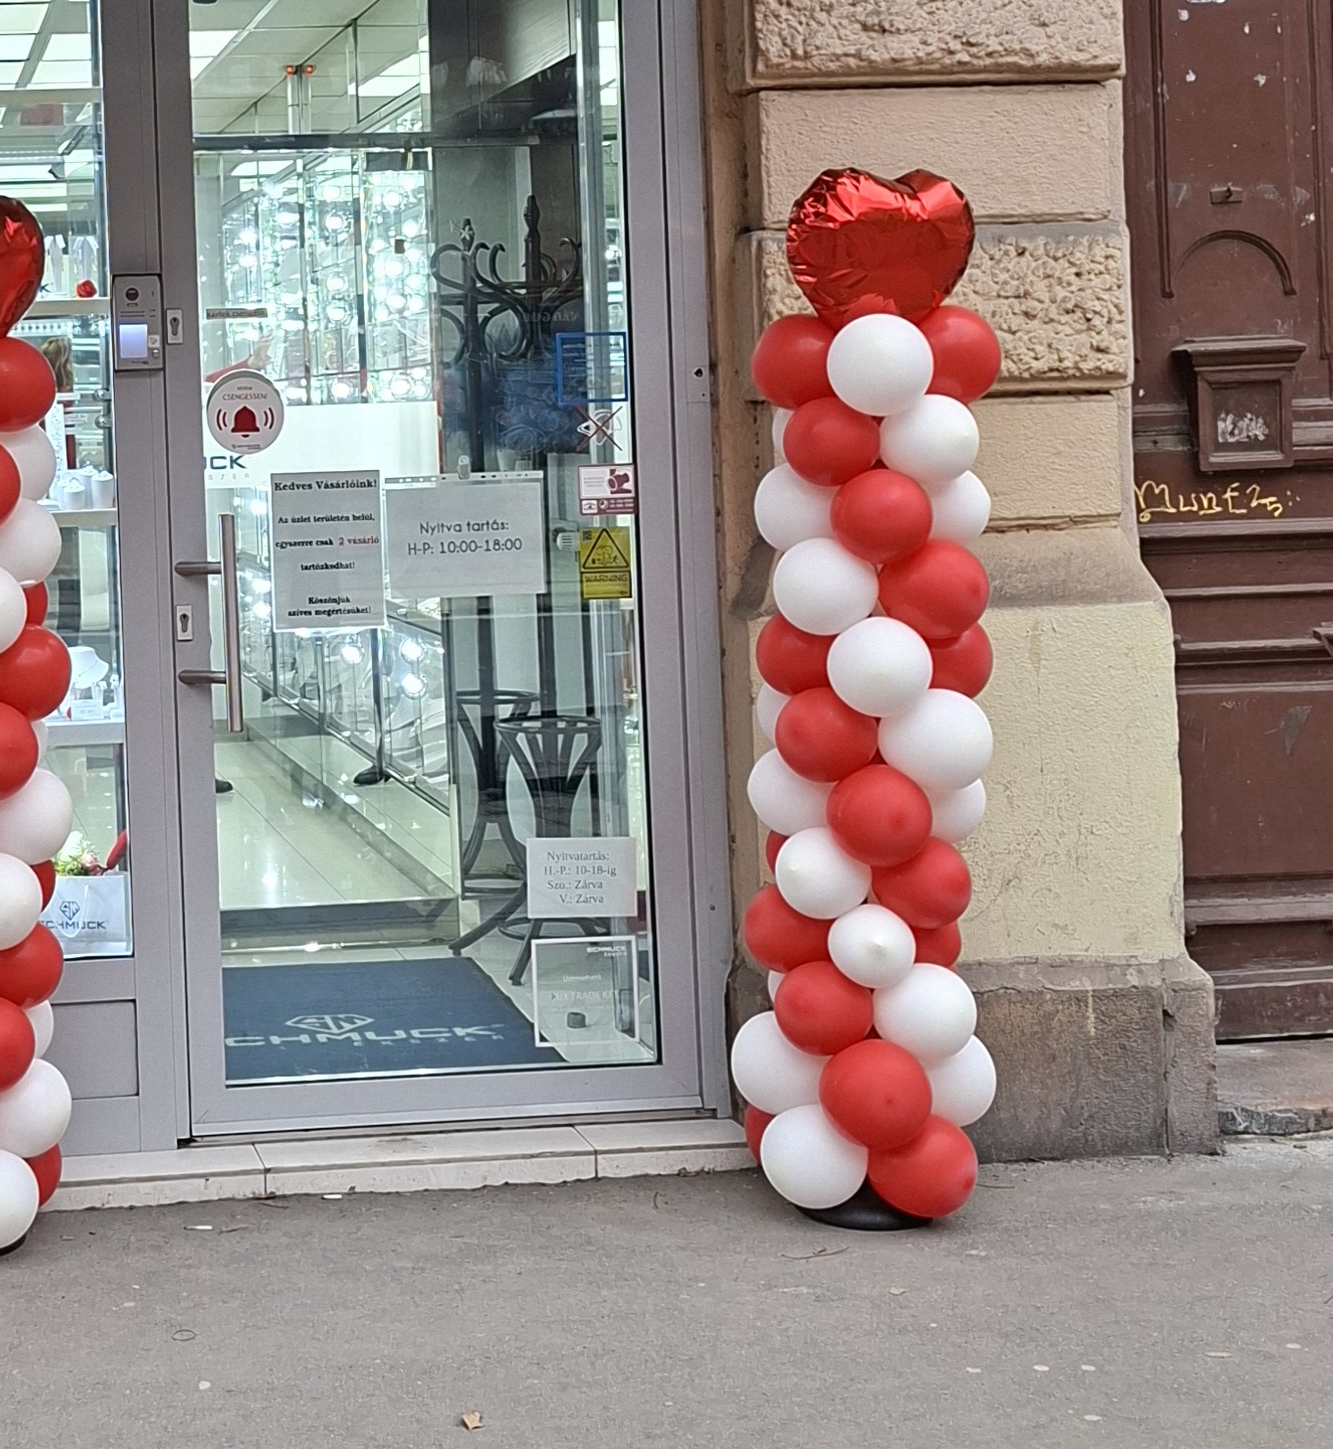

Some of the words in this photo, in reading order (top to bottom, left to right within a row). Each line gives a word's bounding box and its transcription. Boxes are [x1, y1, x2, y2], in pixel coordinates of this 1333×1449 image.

[274, 482, 313, 491] Kedves
[315, 479, 377, 490] Vásárlóink!
[278, 516, 288, 524] Az
[420, 521, 462, 536] Nyitva
[466, 519, 509, 532] tartás:
[315, 538, 334, 546] csak
[338, 537, 344, 545] 2
[347, 536, 379, 545] vásárló
[408, 542, 434, 555] H-P:
[440, 538, 522, 554] 10:00-18:00
[547, 851, 610, 863] Nyitvatartás:
[576, 865, 617, 877] 10-18-ig
[574, 879, 603, 889] Zárva
[575, 892, 604, 903] Zárva
[40, 920, 106, 930] CHMUCK
